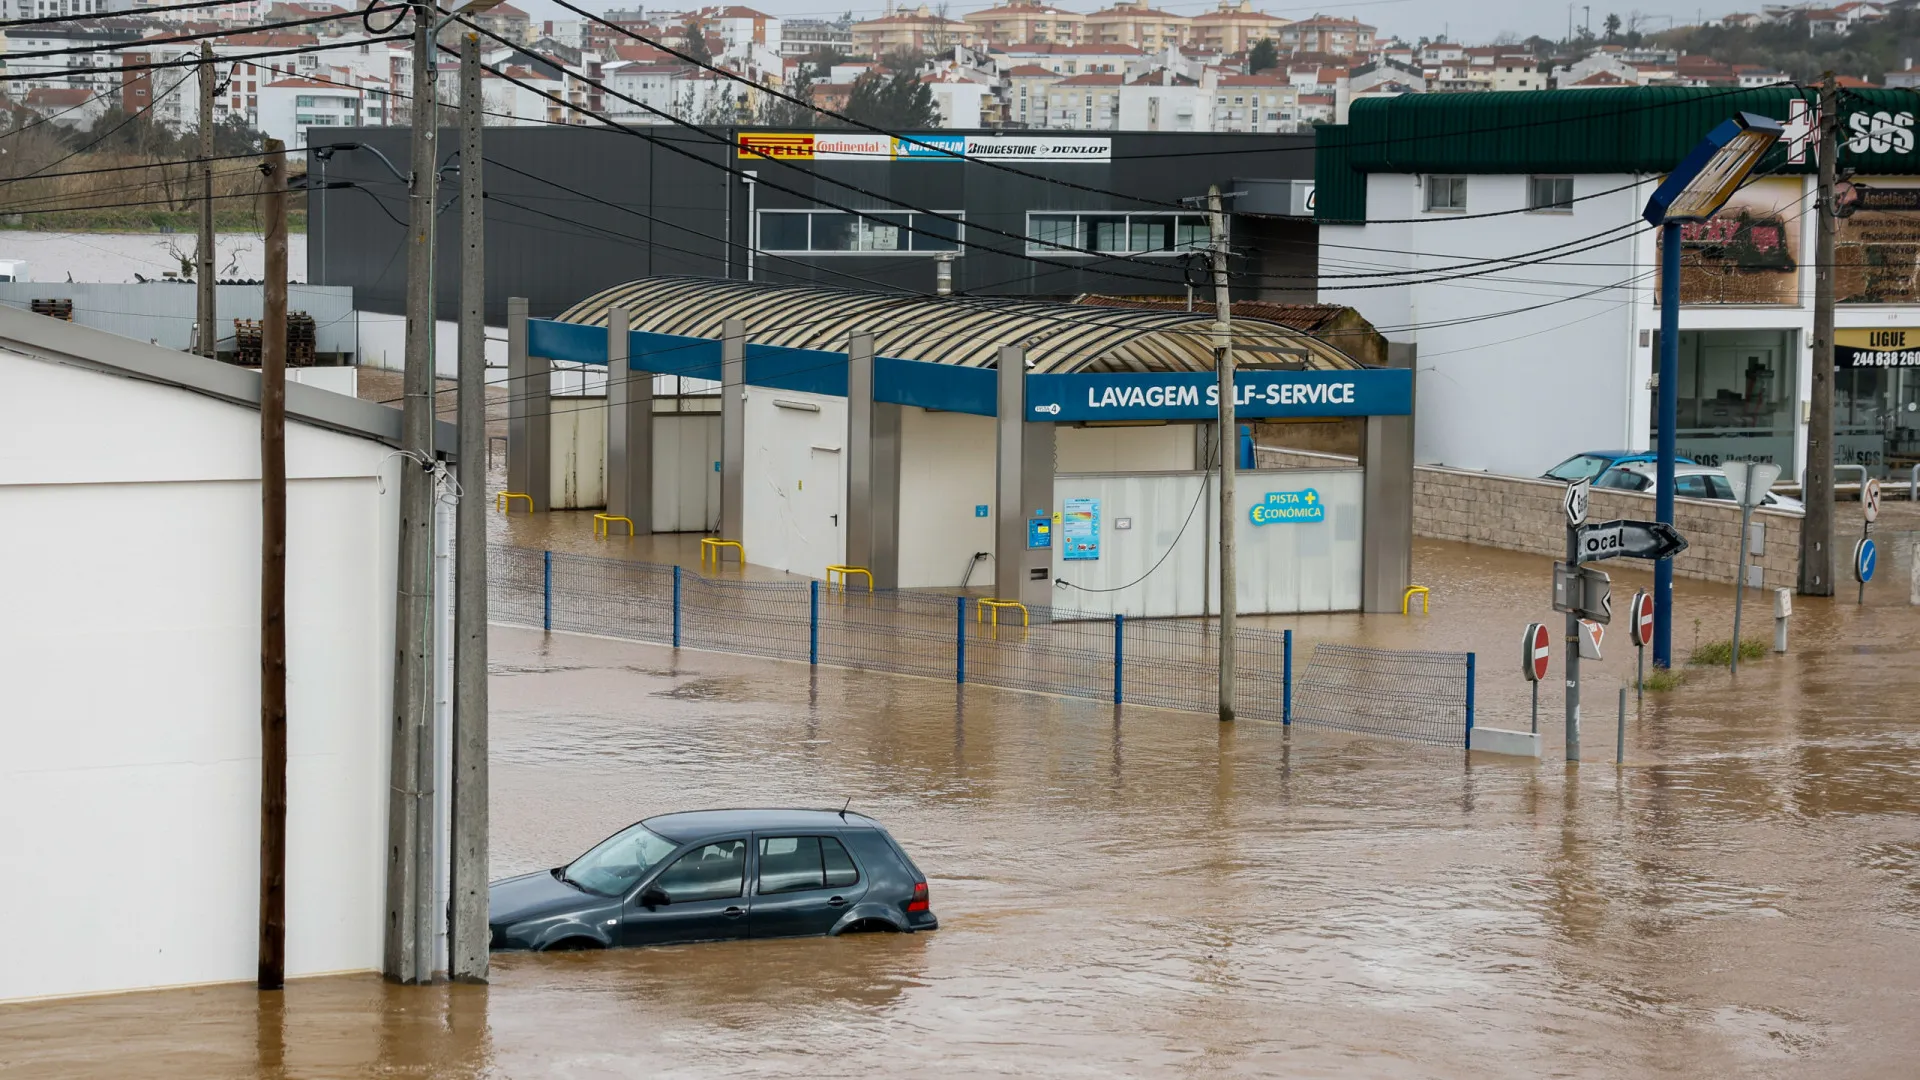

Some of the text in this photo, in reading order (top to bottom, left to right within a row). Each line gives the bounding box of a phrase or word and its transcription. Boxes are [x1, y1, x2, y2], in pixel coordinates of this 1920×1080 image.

[1849, 111, 1914, 154] SOS
[816, 140, 879, 154] Continental
[908, 141, 964, 153] MICHELIN
[967, 143, 1037, 155] BRIDGESTONE
[1051, 146, 1108, 154] DUNLOP
[1863, 191, 1917, 206] Assistência
[1870, 331, 1906, 347] LIGUE
[1852, 351, 1874, 367] 244
[1875, 351, 1898, 367] 838
[1088, 382, 1355, 408] LAVAGEM SLF-SERVICE
[1694, 454, 1719, 468] SOS
[1857, 450, 1881, 466] SOS
[1269, 494, 1299, 504] PISTA
[1582, 528, 1625, 552] ocal
